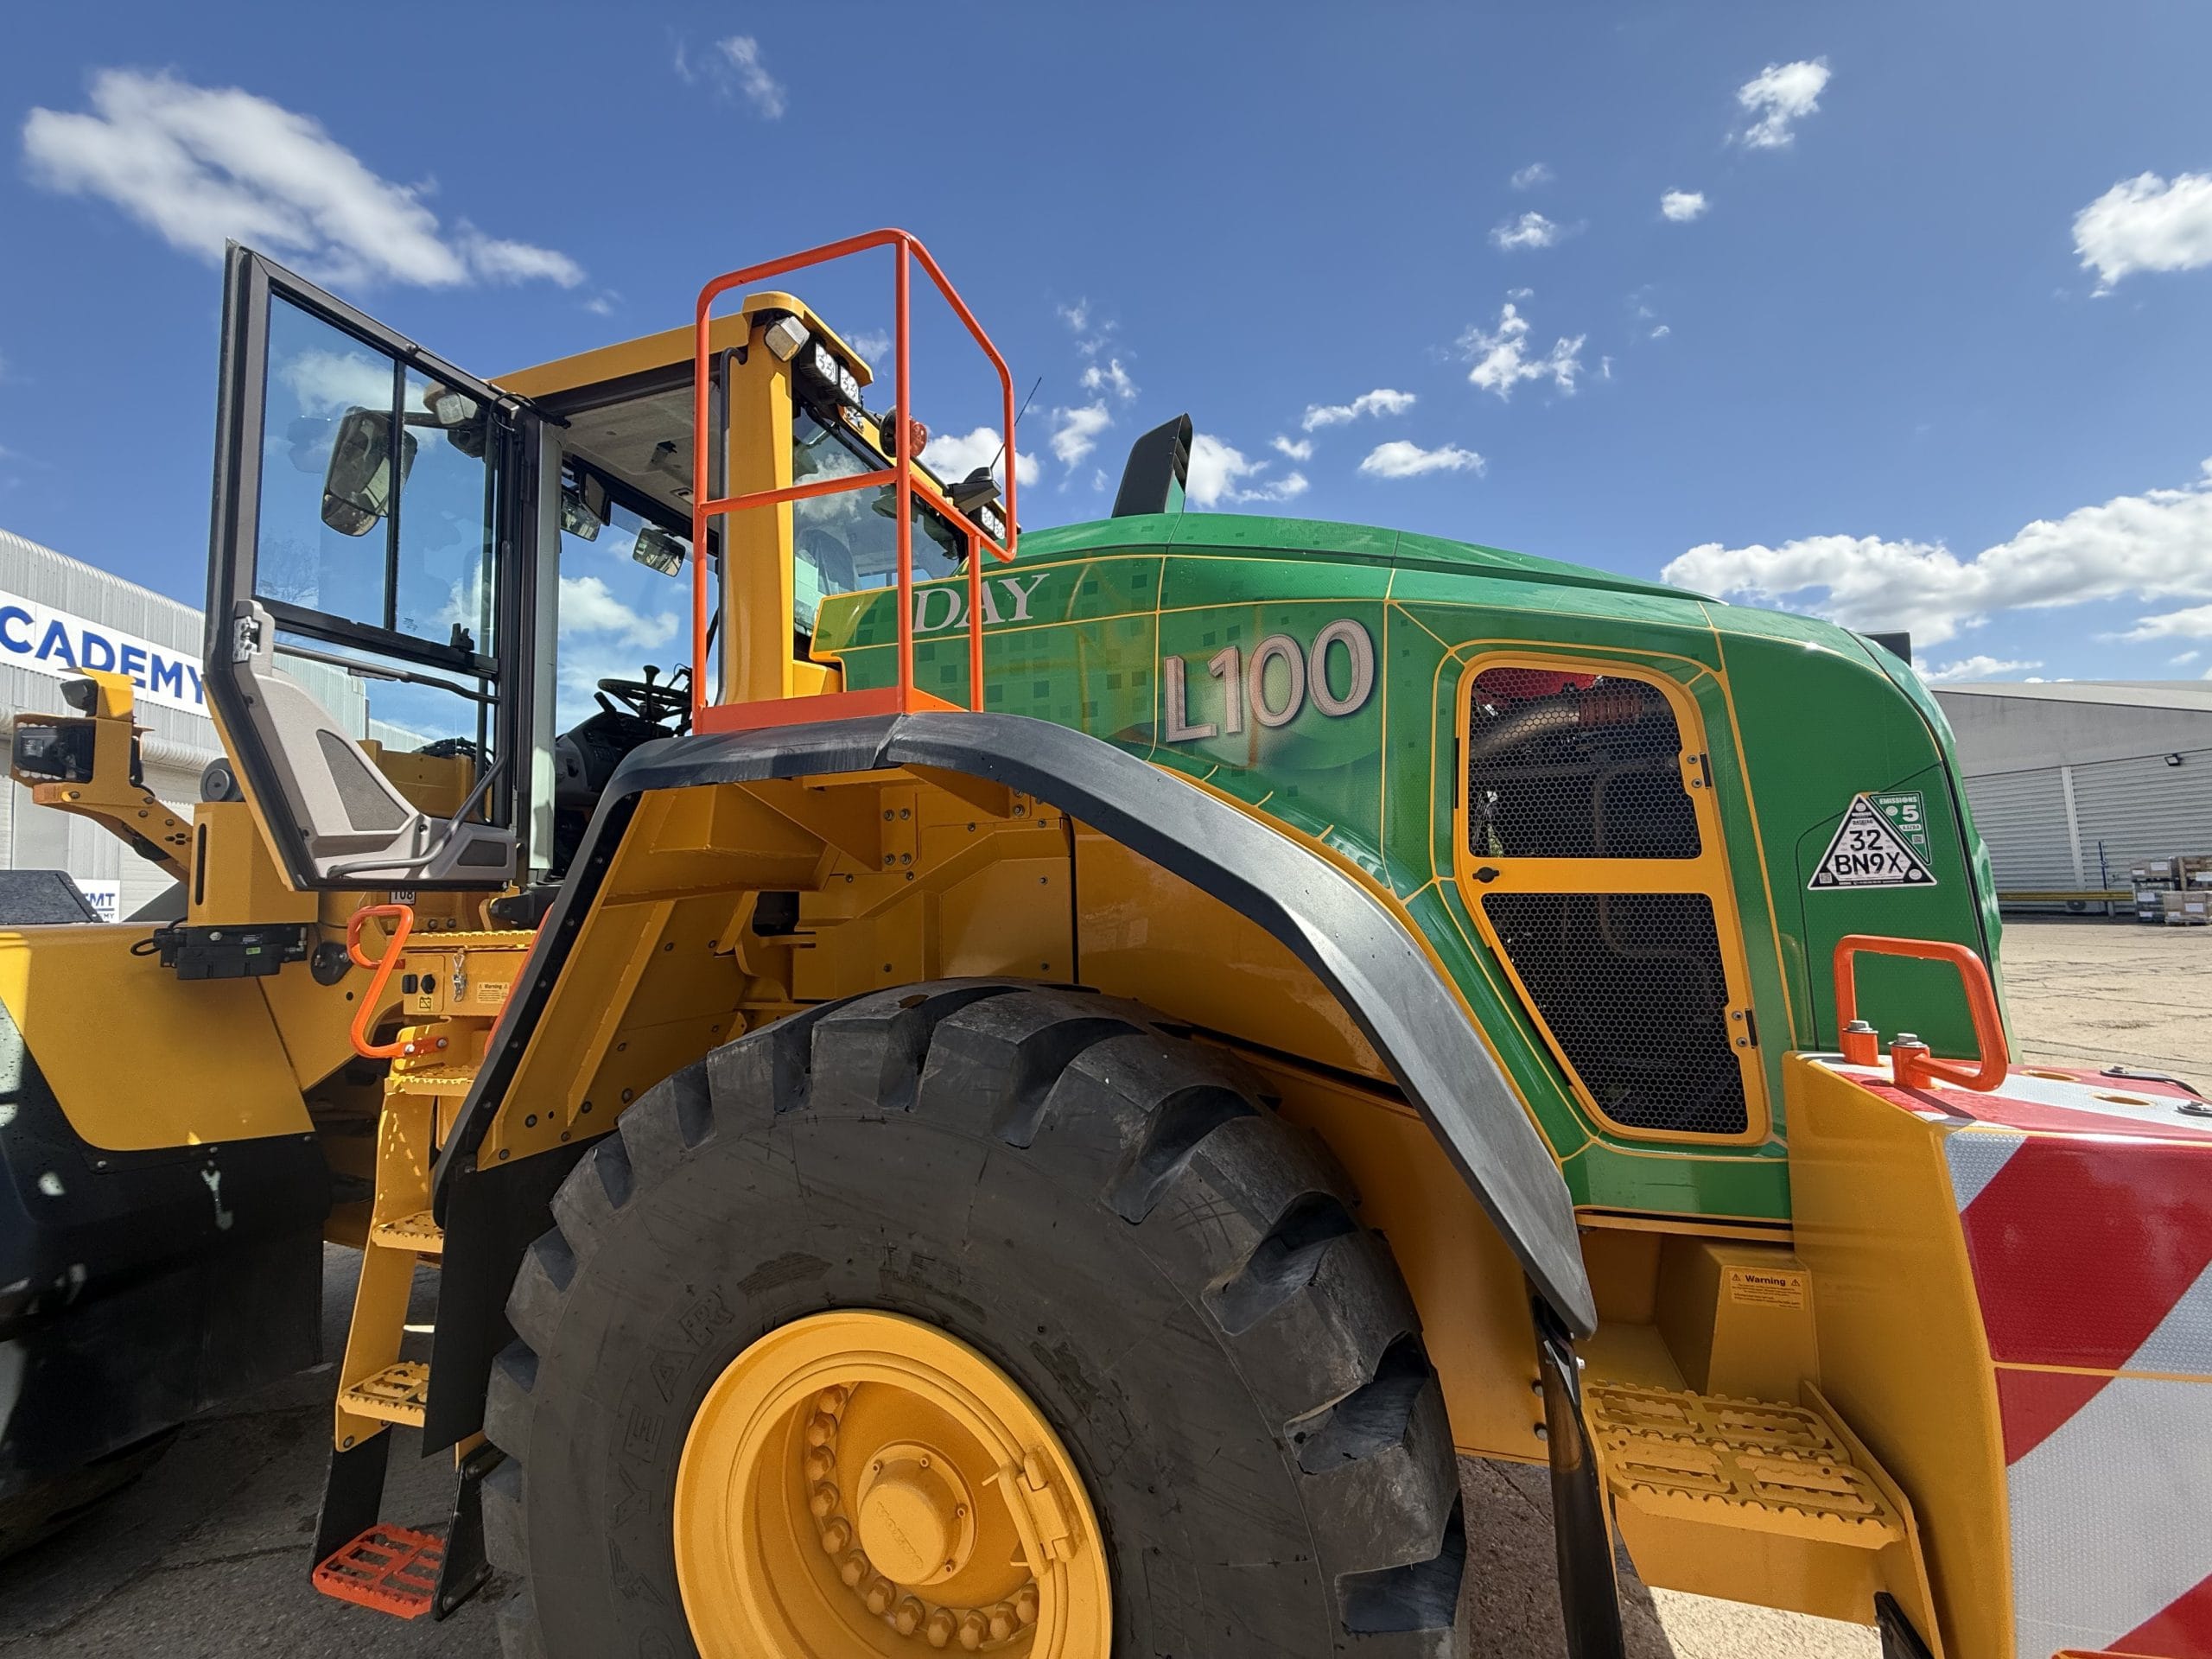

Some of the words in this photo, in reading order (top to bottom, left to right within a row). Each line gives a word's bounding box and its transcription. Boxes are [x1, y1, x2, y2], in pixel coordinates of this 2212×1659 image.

[912, 573, 1050, 633] DAY
[1164, 619, 1375, 742] L100
[1878, 796, 1917, 804] EMISSIONS
[1902, 804, 1920, 822] 5
[1849, 830, 1884, 851] 32
[1834, 852, 1904, 875] BN9X
[86, 893, 116, 906] MT
[1745, 1274, 1786, 1287] Warning
